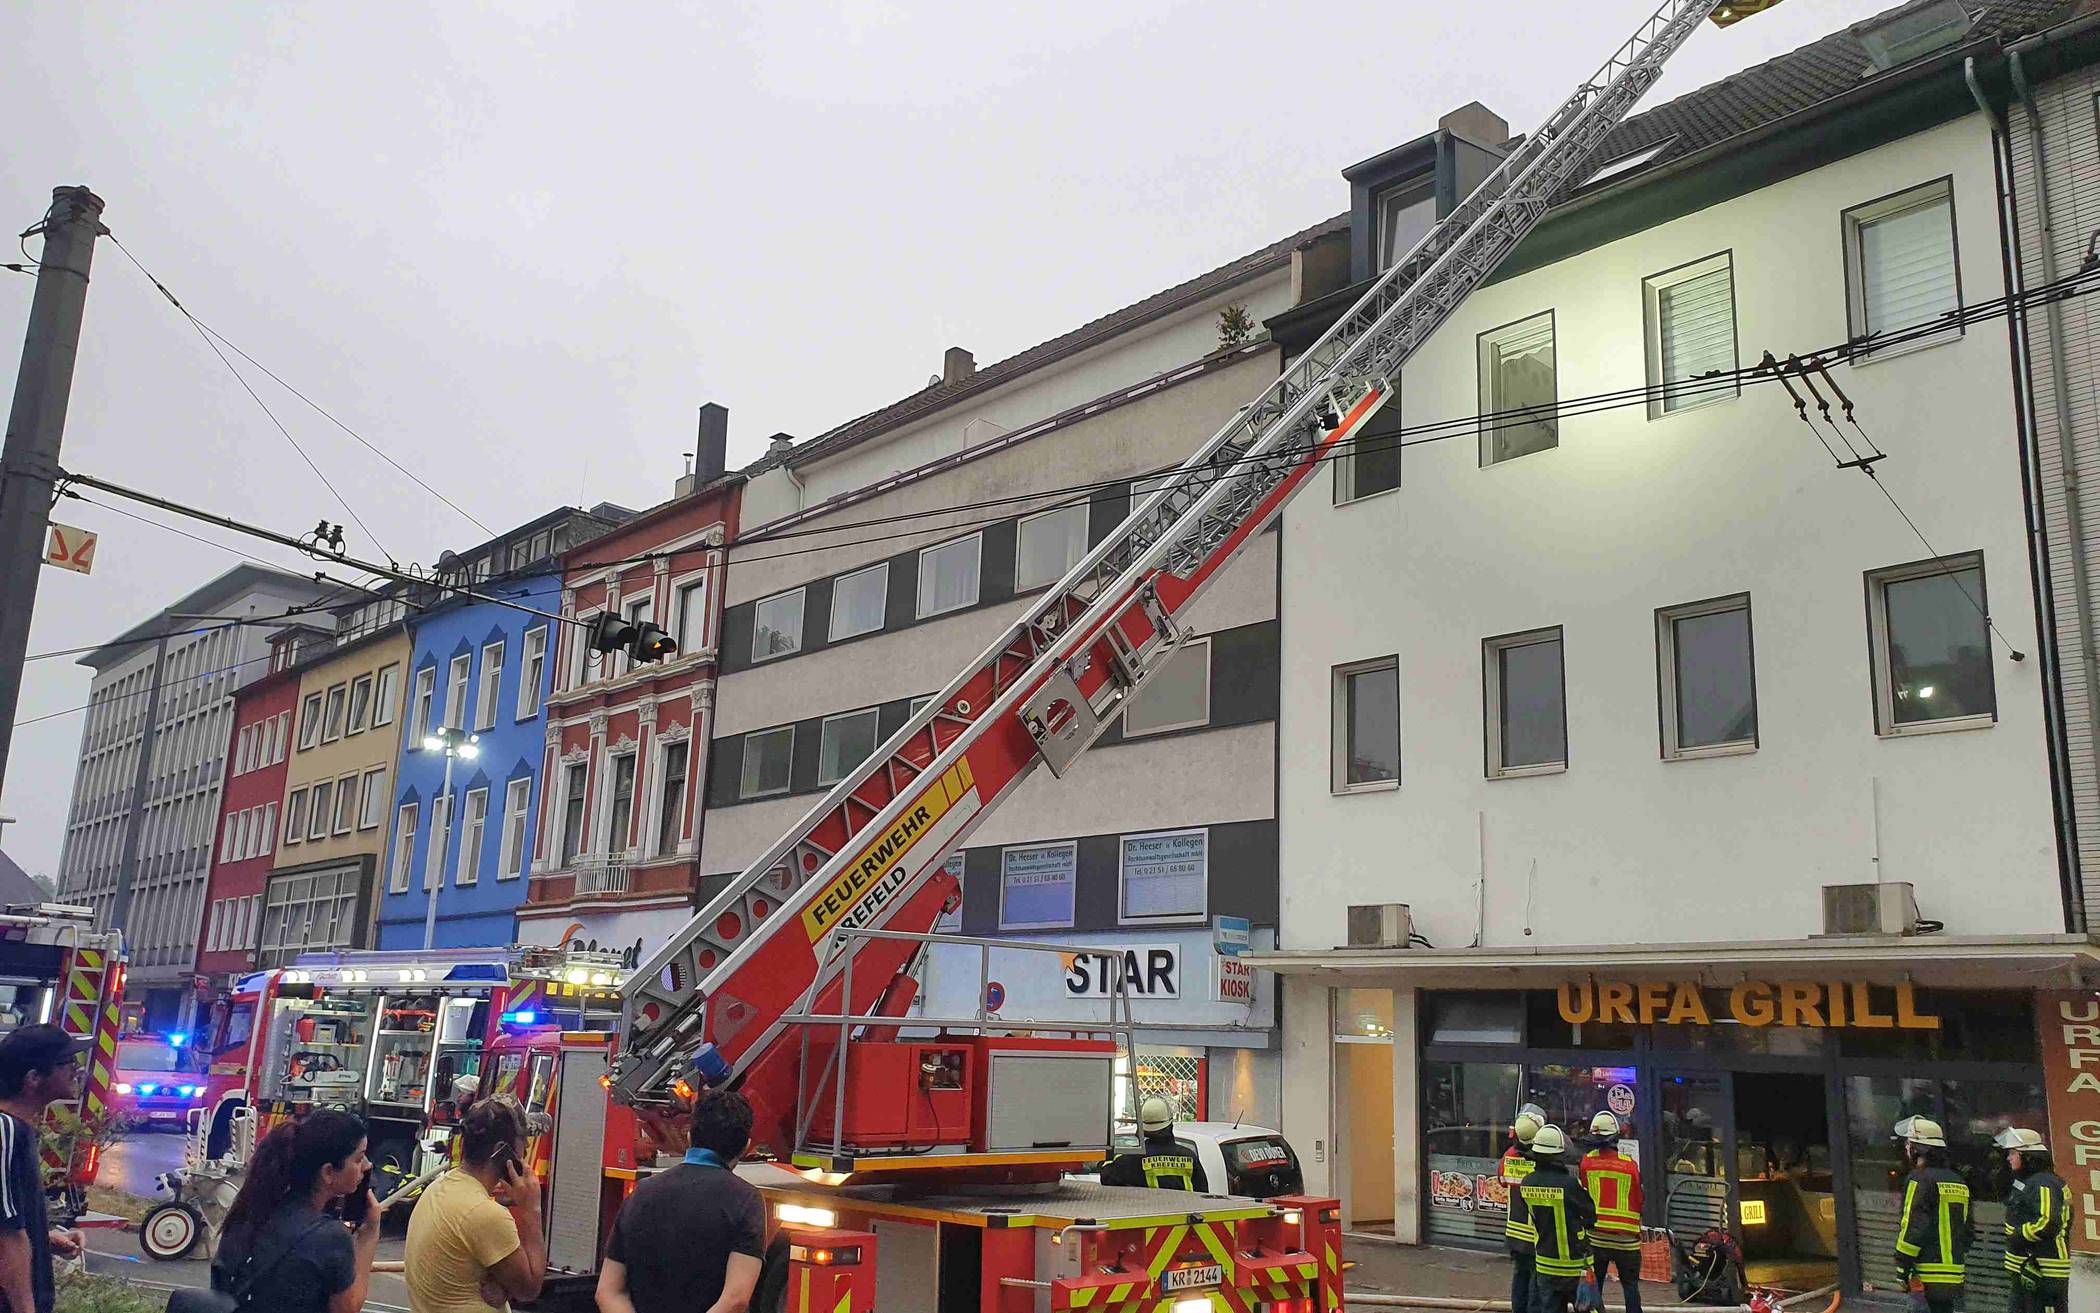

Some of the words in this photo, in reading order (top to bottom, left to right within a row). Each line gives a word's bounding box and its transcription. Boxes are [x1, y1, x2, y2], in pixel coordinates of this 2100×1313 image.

[1172, 839, 1203, 848] Kollegen
[1047, 850, 1073, 859] Kollegen
[812, 806, 931, 926] FEUERWEHR
[1066, 950, 1175, 994] STAR
[1225, 961, 1250, 977] STAR
[1220, 981, 1250, 998] KIOSK
[1556, 981, 1712, 1025] URFA
[1729, 980, 1942, 1029] GRILL
[1142, 1156, 1192, 1164] FEUERWEHR
[1744, 1205, 1763, 1220] GRILL
[1172, 1271, 1185, 1287] KR
[1194, 1268, 1218, 1284] 2144
